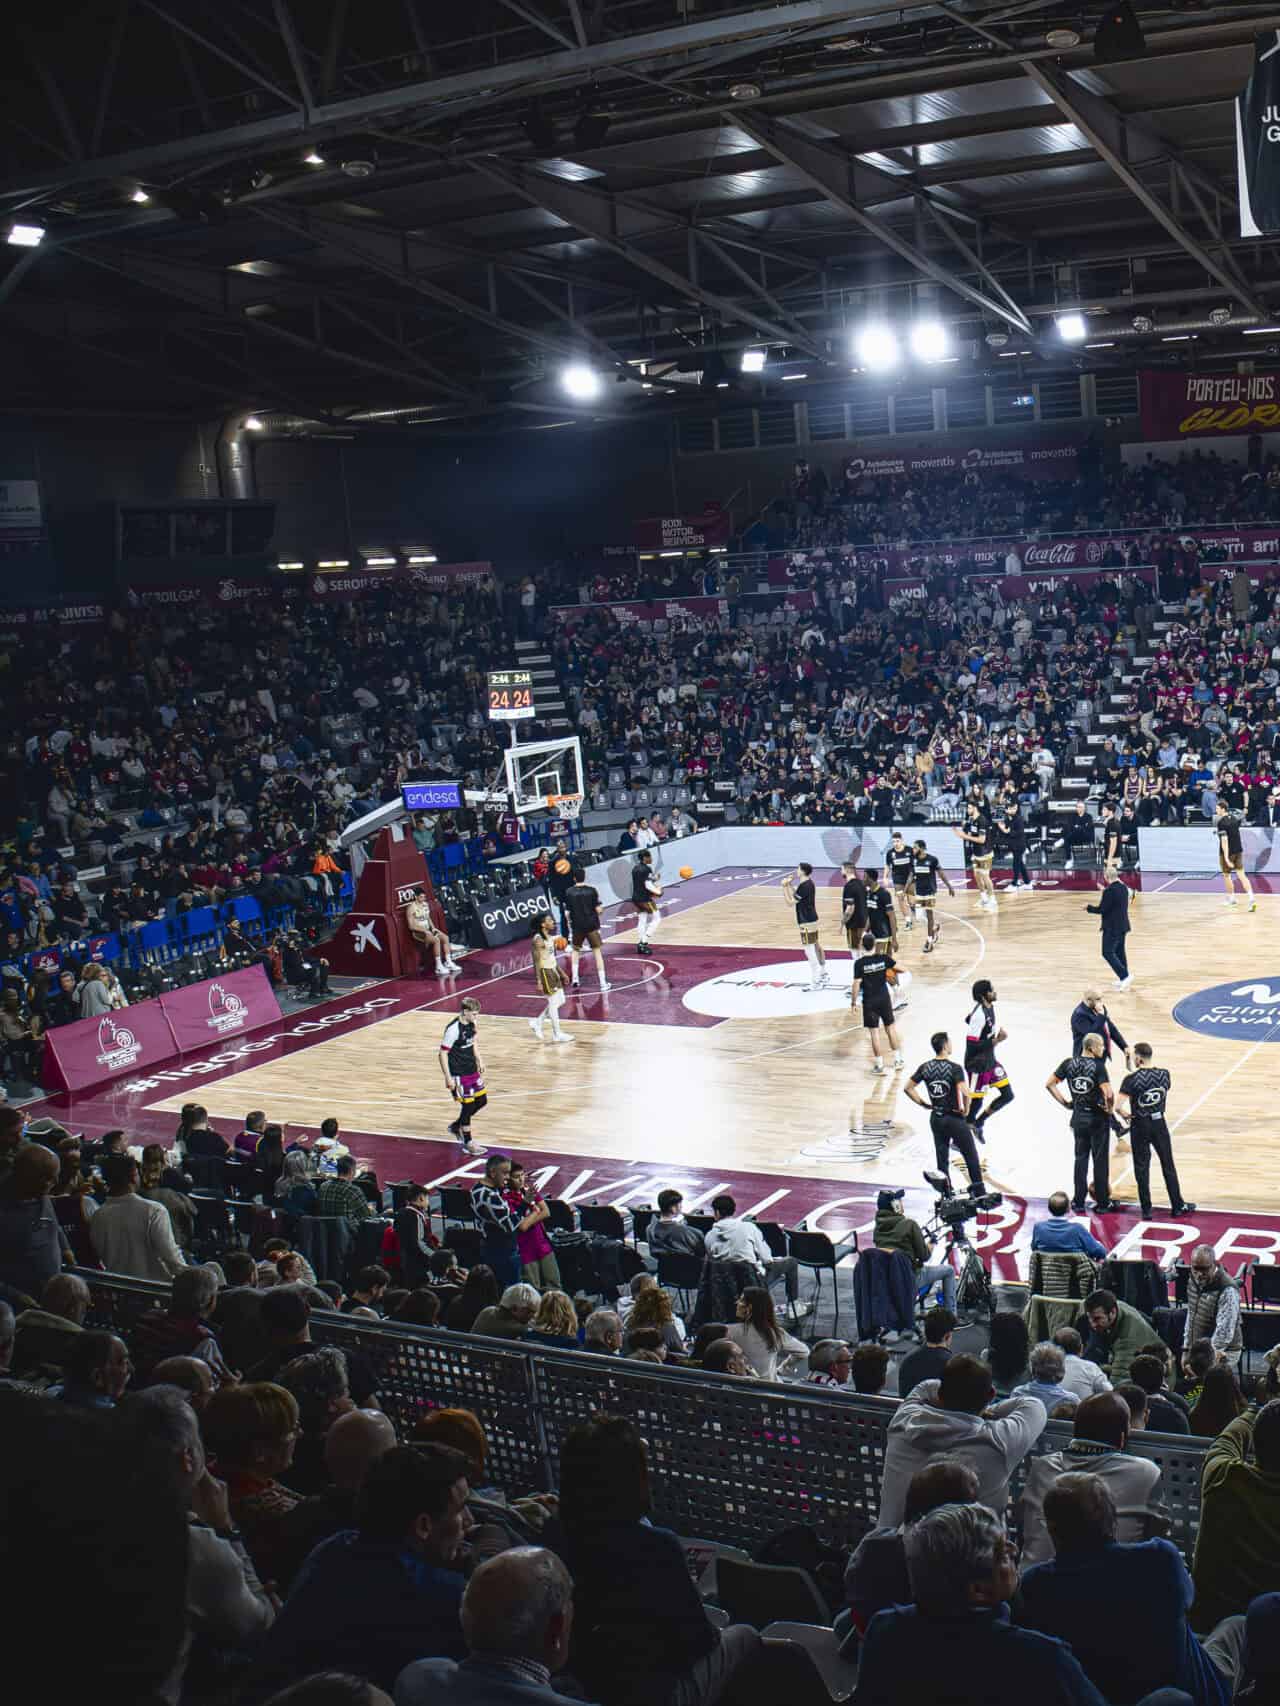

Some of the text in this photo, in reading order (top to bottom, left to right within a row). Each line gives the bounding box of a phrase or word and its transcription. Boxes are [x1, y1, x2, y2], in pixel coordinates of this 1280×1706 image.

[1186, 375, 1275, 401] PORTEU-NOS
[662, 520, 683, 529] RODI
[663, 528, 693, 537] MOTOR
[490, 689, 531, 708] 24 24
[407, 789, 458, 805] endesa
[484, 803, 509, 812] ende
[483, 895, 549, 930] endesa
[125, 996, 401, 1093] #ligaendesa
